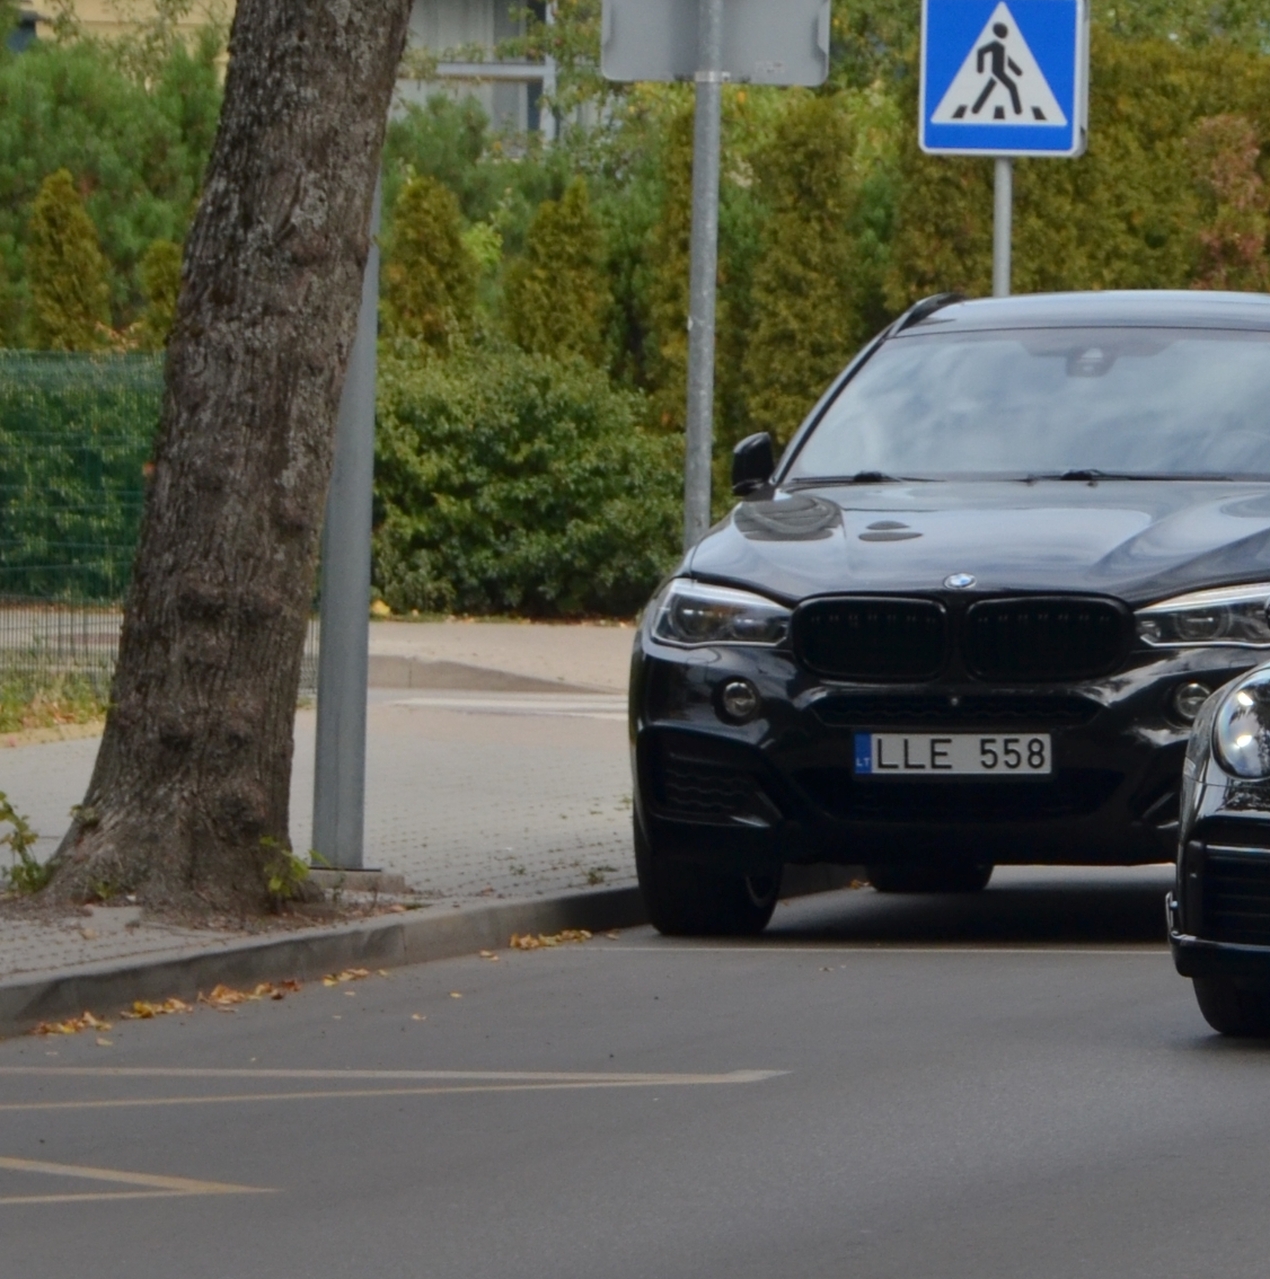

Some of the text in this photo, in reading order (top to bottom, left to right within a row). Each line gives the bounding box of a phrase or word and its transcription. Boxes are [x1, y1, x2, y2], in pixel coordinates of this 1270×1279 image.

[855, 757, 871, 767] LT
[877, 738, 1045, 770] LLE 558
